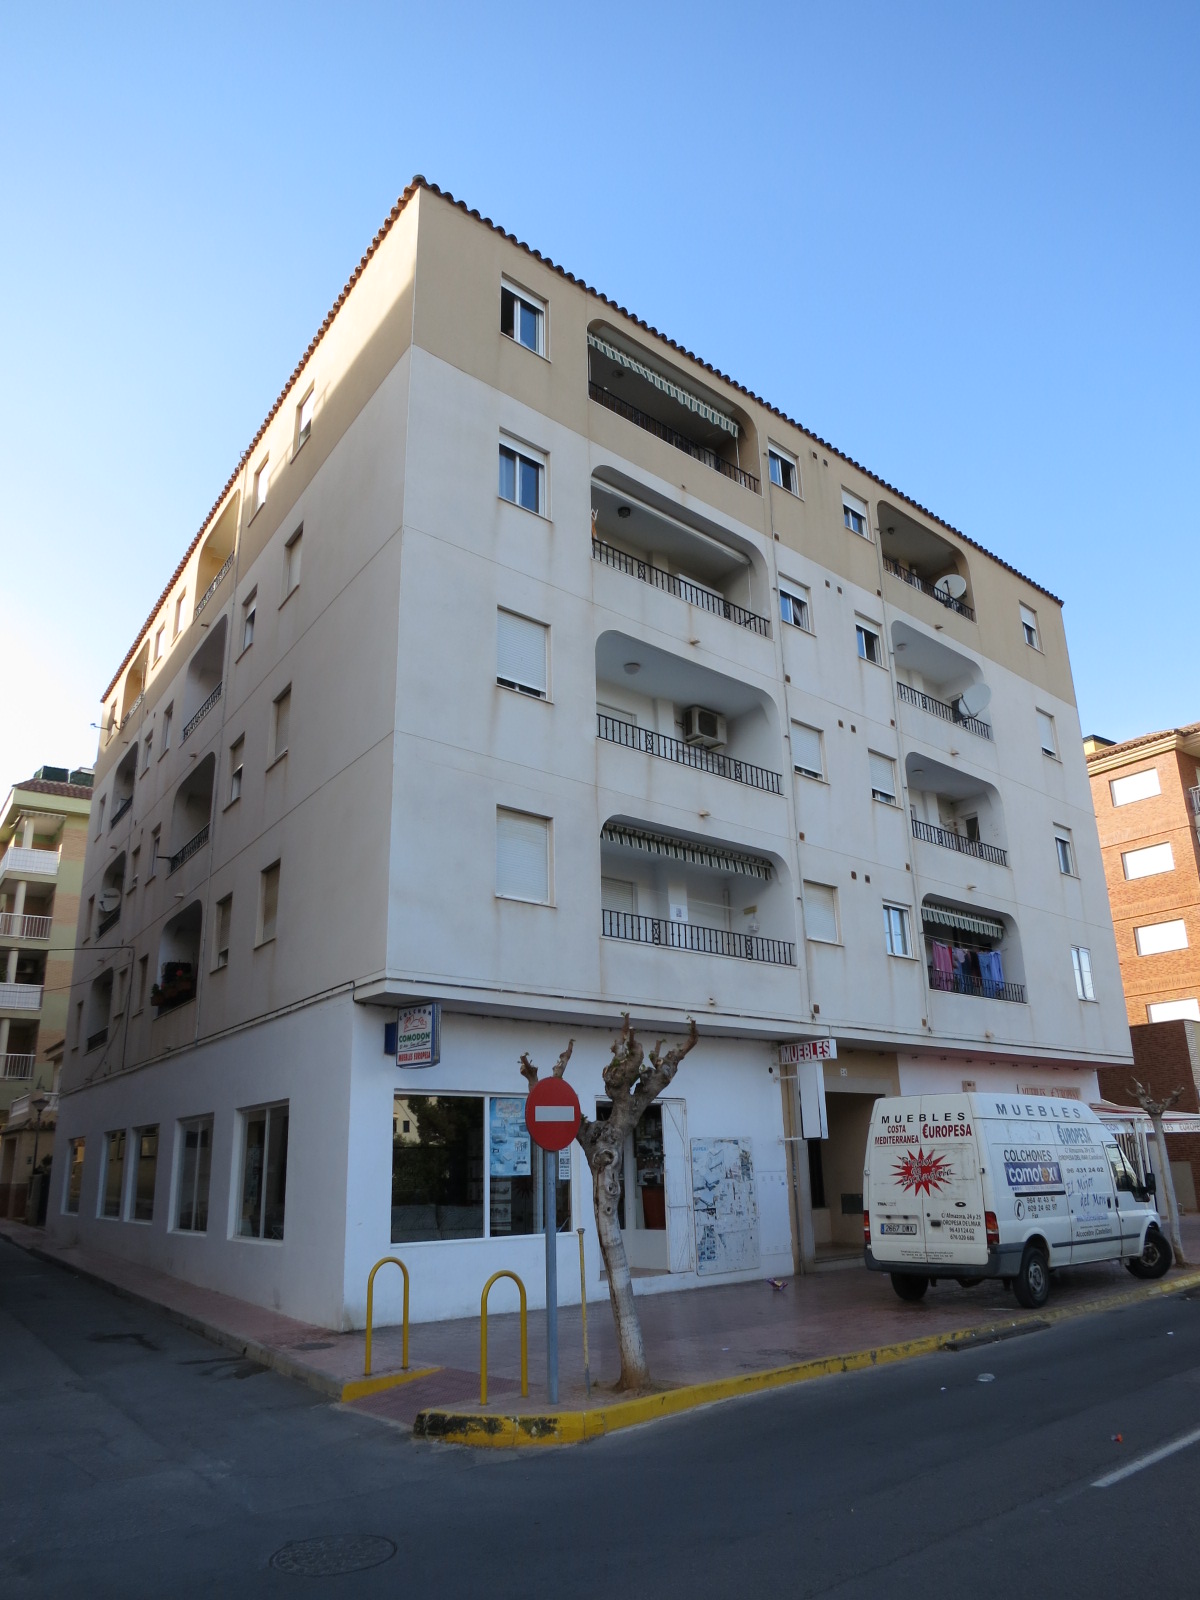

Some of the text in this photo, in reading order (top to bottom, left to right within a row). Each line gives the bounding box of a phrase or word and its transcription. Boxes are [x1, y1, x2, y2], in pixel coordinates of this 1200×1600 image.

[398, 1032, 431, 1043] COMODON
[782, 1040, 831, 1063] MUEBLES
[995, 1103, 1081, 1119] MUEBLES
[881, 1112, 965, 1124] MUEBLES
[887, 1124, 907, 1134] COSTA
[874, 1134, 919, 1145] MEDITERRANEA
[1003, 1149, 1053, 1162] COLCHONES
